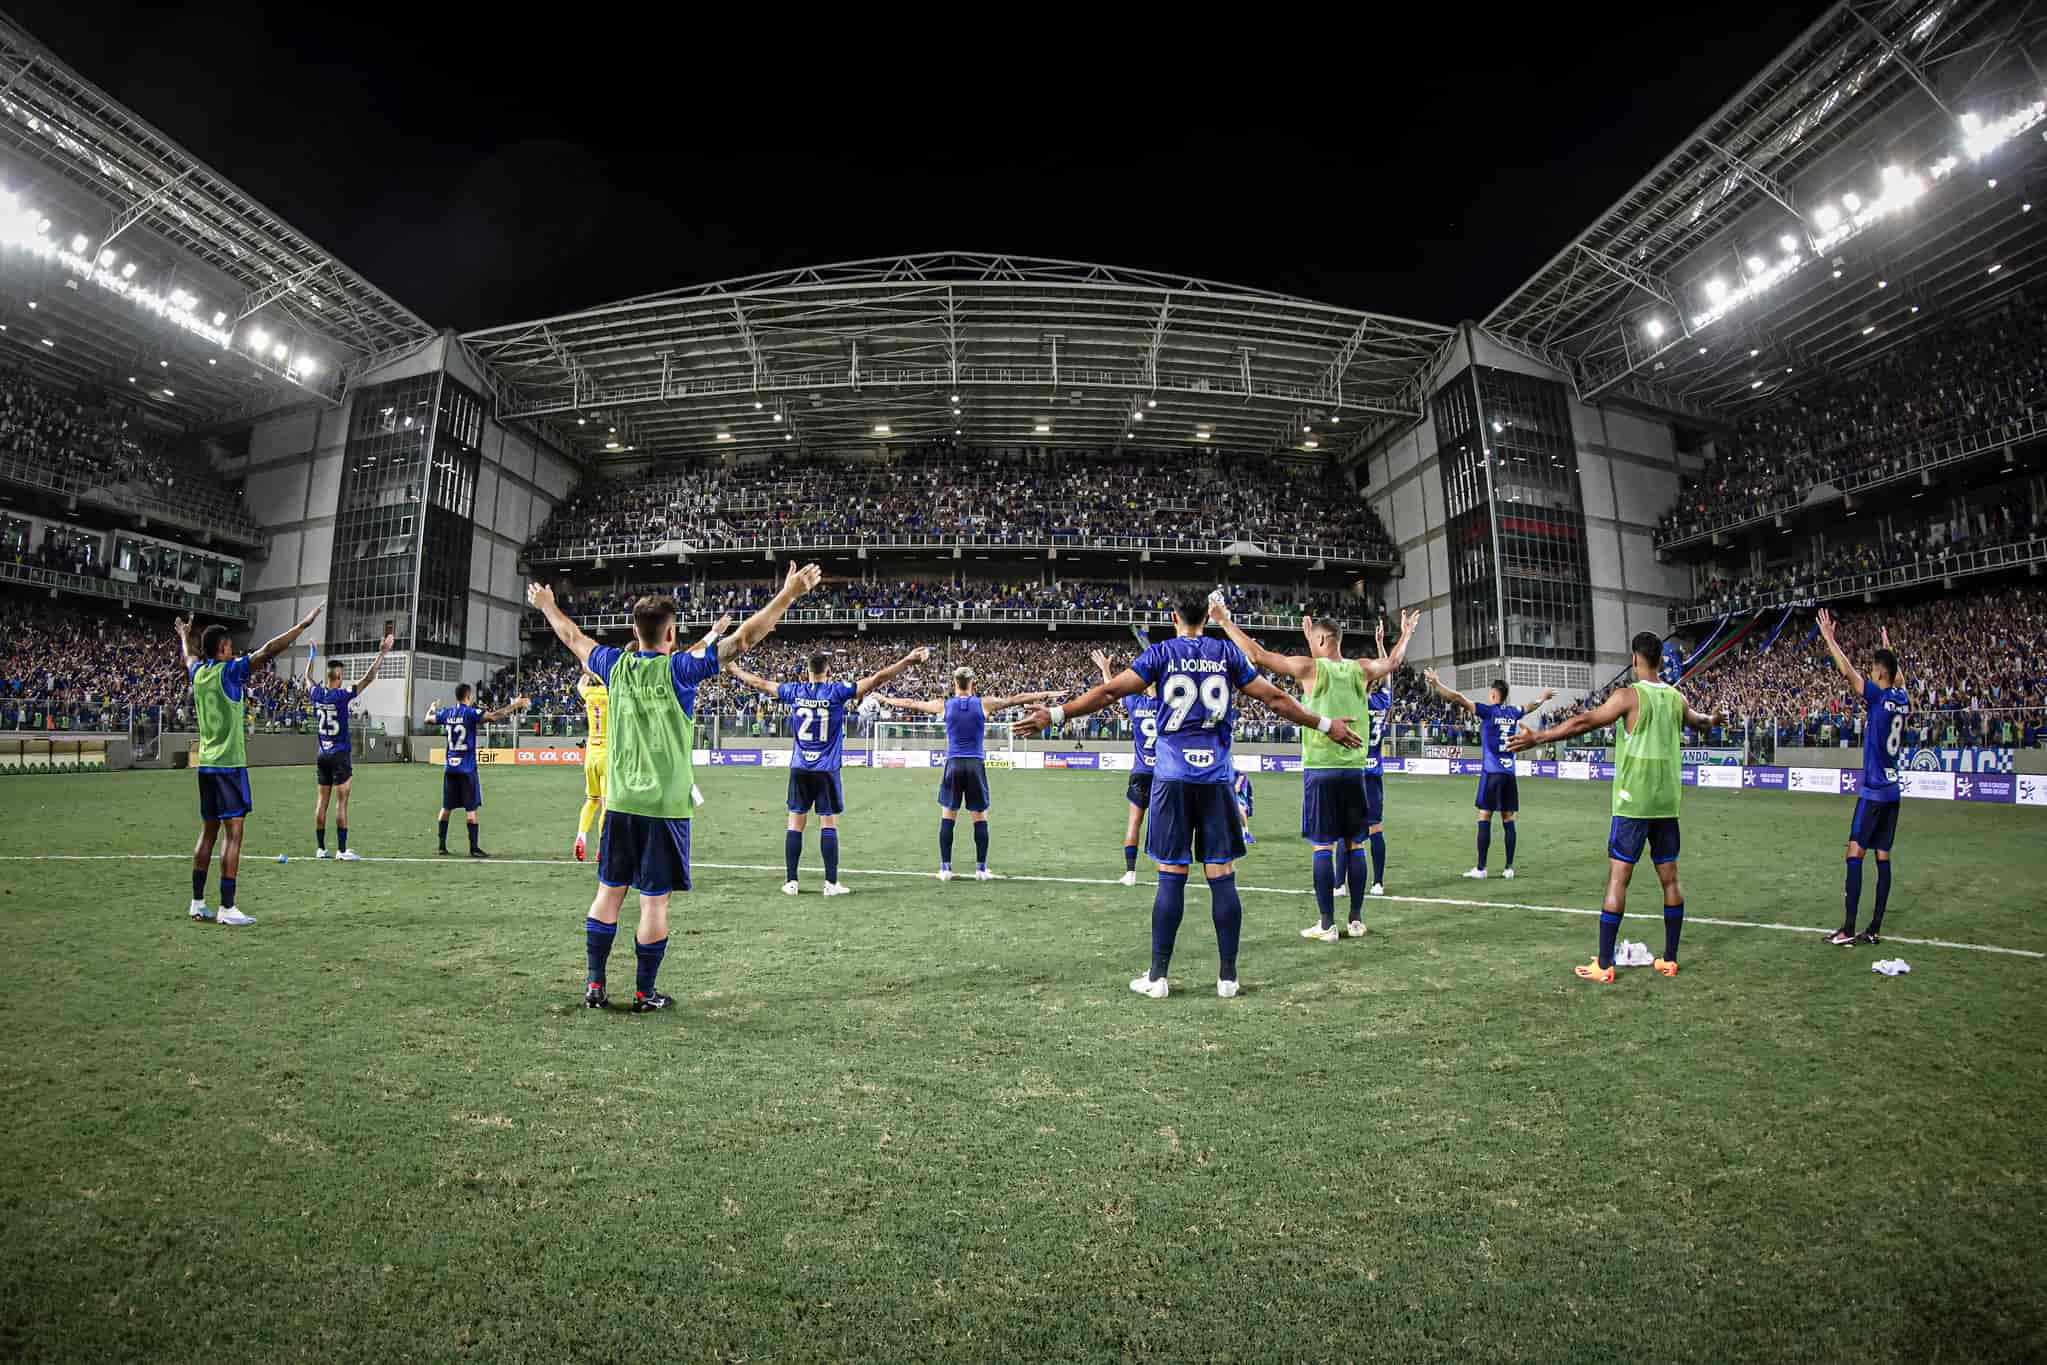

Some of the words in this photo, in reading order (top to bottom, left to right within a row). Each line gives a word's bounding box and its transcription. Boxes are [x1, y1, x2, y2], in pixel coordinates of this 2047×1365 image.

[1181, 658, 1227, 672] DOURADO
[1163, 674, 1229, 731] 99
[316, 709, 340, 735] 25
[796, 707, 829, 742] 21
[1140, 718, 1157, 749] 9
[446, 723, 468, 751] 12
[1886, 714, 1903, 757] 8
[478, 750, 498, 763] fair
[518, 751, 537, 761] GOL
[540, 751, 558, 761] GOL
[562, 751, 581, 761] GOL
[1188, 754, 1209, 763] BH
[1682, 751, 1709, 761] ANDO
